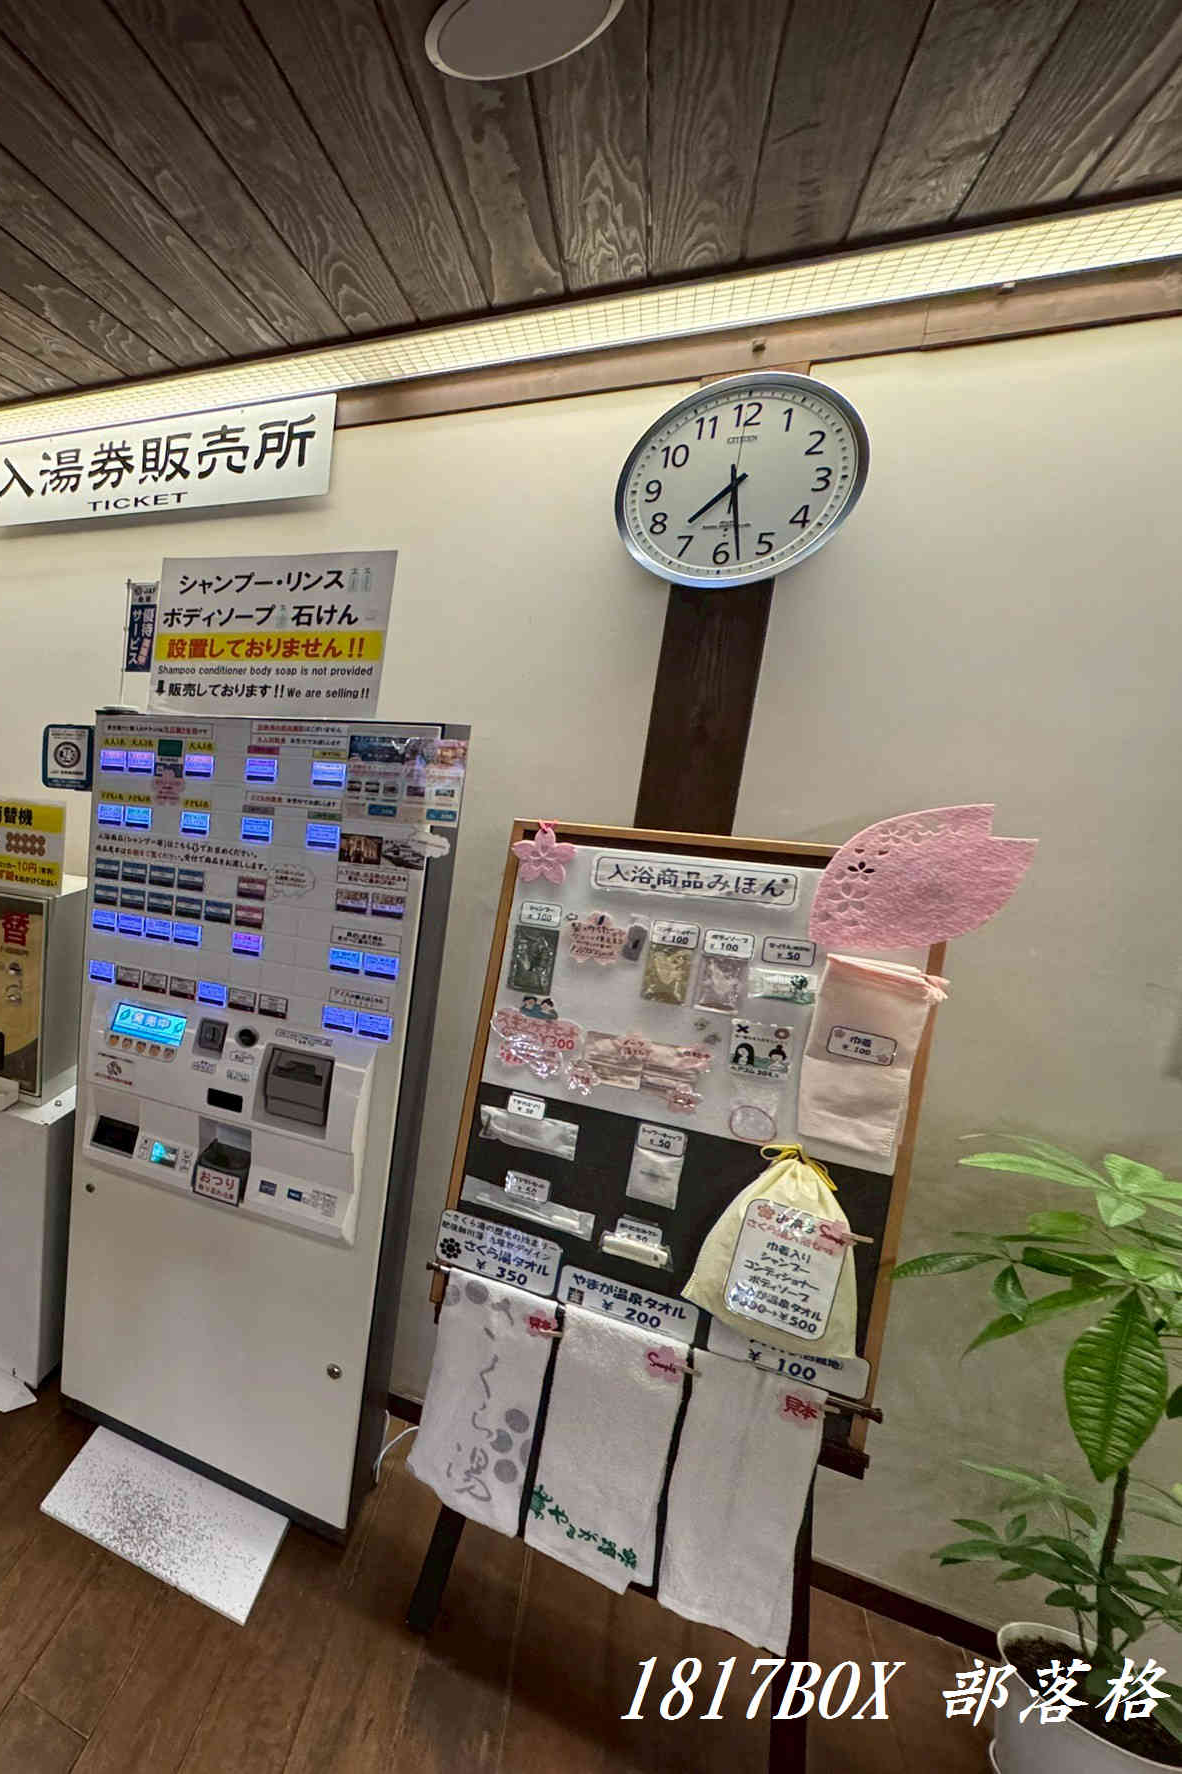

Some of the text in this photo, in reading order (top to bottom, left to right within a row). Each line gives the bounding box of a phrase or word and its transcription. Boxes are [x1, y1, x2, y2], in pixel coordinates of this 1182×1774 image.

[733, 402, 763, 428] 12
[783, 408, 794, 432] 1
[695, 416, 718, 440] 11
[805, 431, 826, 455] 2
[661, 444, 690, 468] 10
[811, 467, 832, 492] 3
[88, 492, 188, 512] TICKET
[644, 480, 662, 503] 9
[650, 512, 667, 535] 8
[789, 505, 810, 528] 4
[676, 535, 693, 557] 7
[712, 542, 730, 564] 6
[755, 532, 775, 556] 5
[179, 569, 345, 595] シャンプー・リンス
[163, 604, 359, 628] ボディソープ 石けん
[128, 609, 142, 665] サービス
[157, 665, 373, 677] Shampoo conditioner body soap is not provided
[286, 688, 302, 698] We
[306, 690, 322, 698] are
[608, 863, 785, 898] 入浴商品みほん
[671, 935, 689, 945] 100
[720, 942, 738, 953] 100
[657, 1139, 671, 1149] 50
[199, 1170, 235, 1192] おつり
[464, 1239, 550, 1277] さくら湯タオル
[759, 1253, 811, 1274] シャンプー
[495, 1266, 528, 1286] 350
[572, 1272, 687, 1320] やまが温泉タオル
[749, 1275, 810, 1302] ボディソープ
[624, 1308, 661, 1328] 200
[778, 1358, 816, 1381] 100
[784, 1395, 818, 1421] 見本
